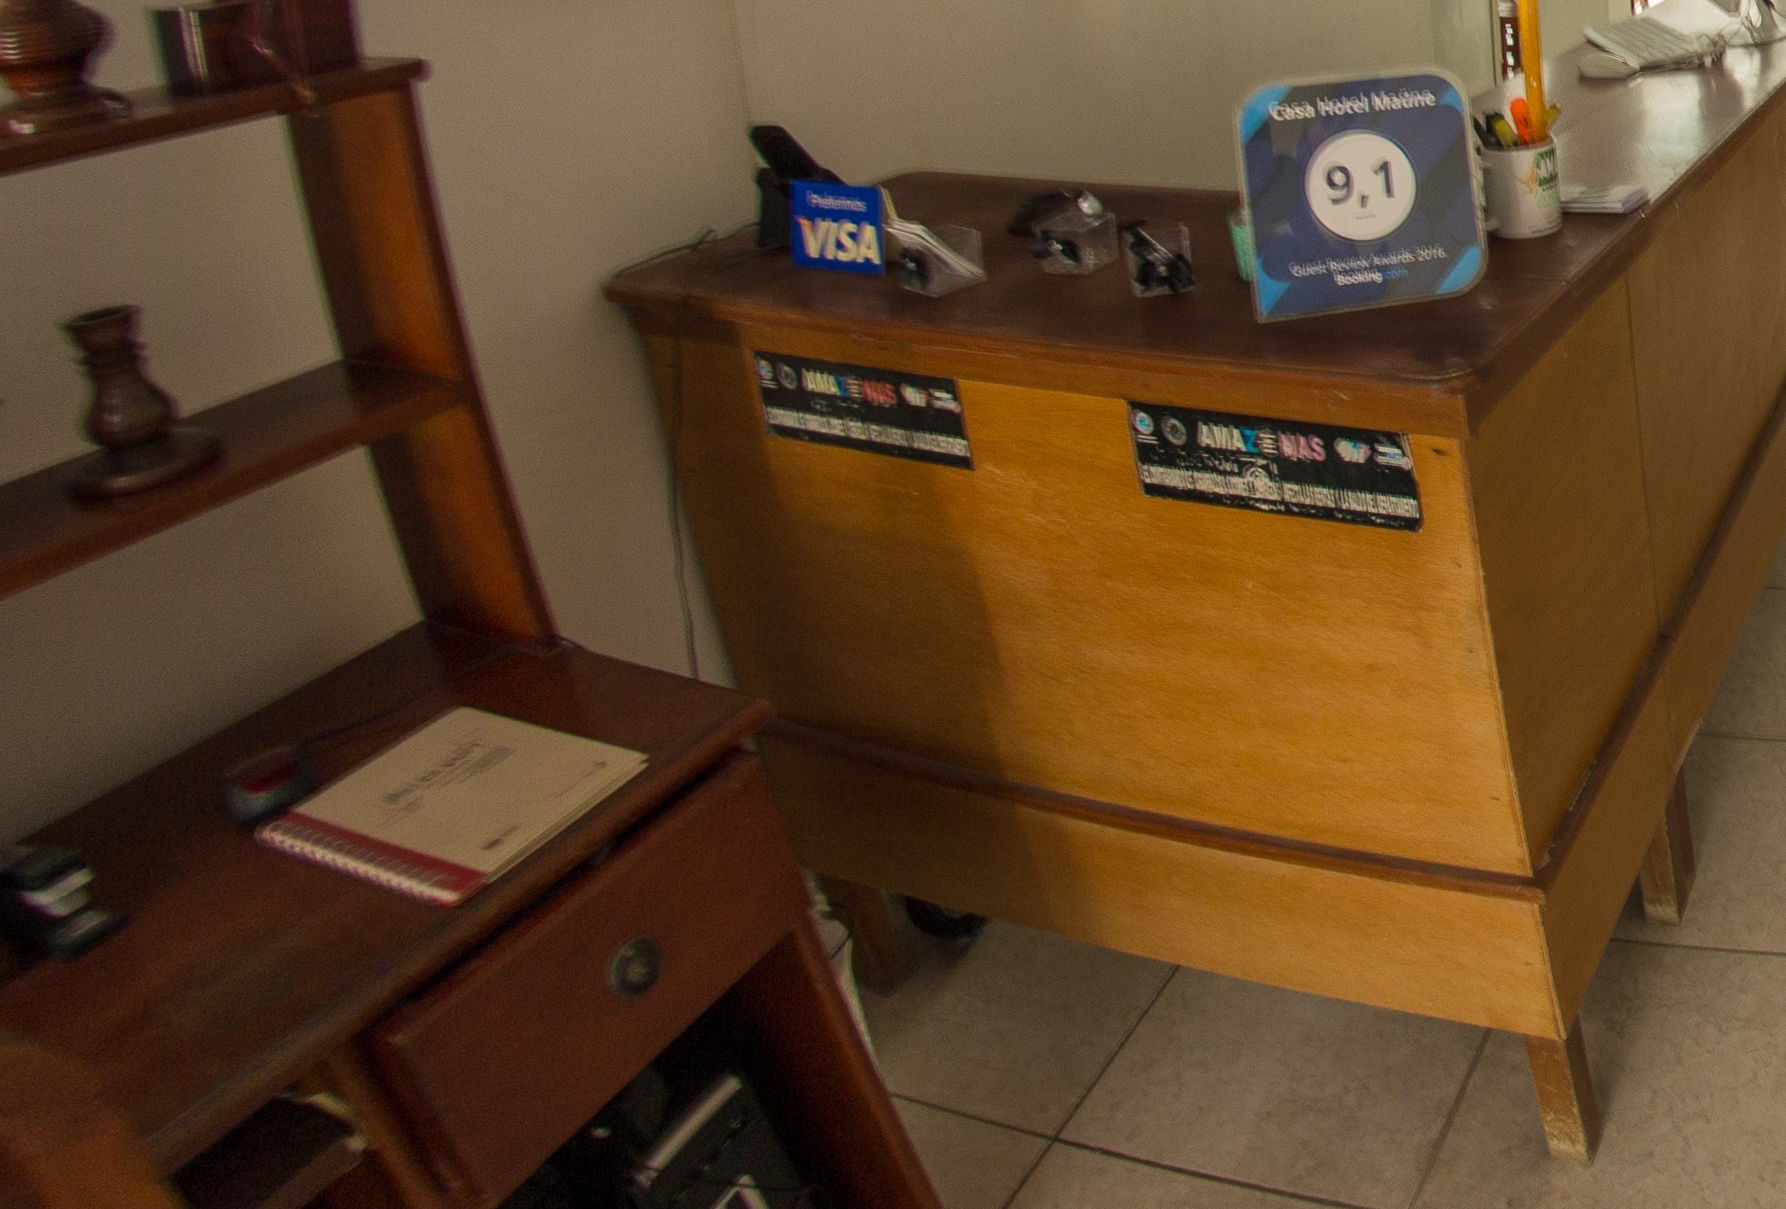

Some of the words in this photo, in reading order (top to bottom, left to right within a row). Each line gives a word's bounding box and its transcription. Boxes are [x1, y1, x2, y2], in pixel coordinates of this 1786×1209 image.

[1269, 100, 1316, 122] Casa
[1318, 92, 1369, 117] Hotel
[1324, 158, 1396, 210] 9,1
[794, 216, 882, 265] VISA
[1371, 247, 1416, 266] Awards
